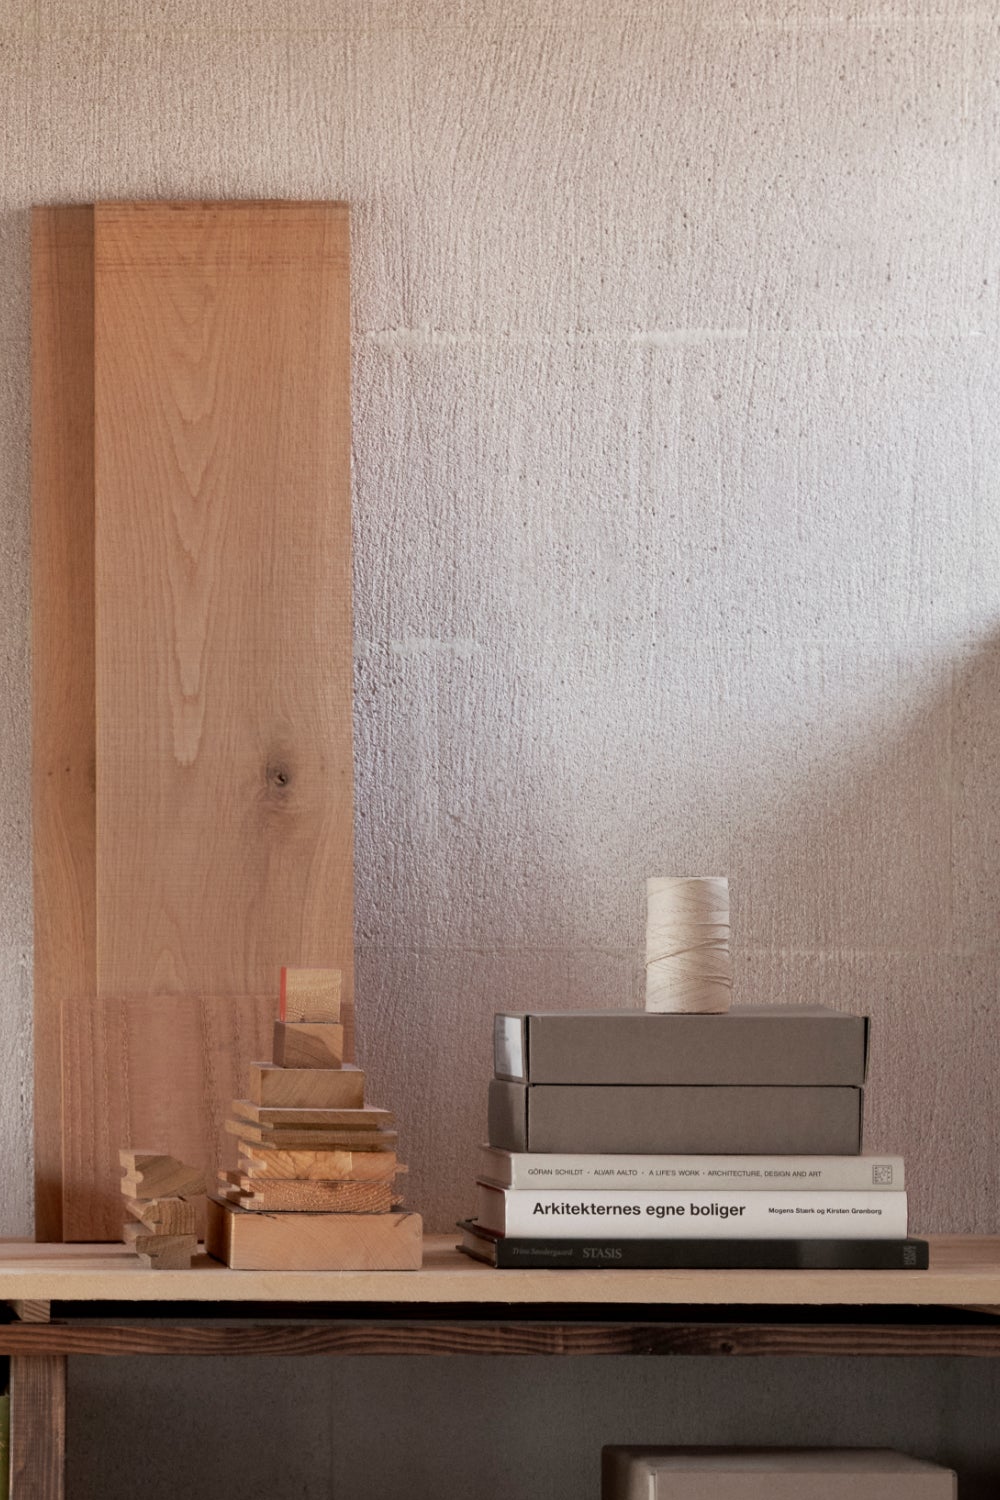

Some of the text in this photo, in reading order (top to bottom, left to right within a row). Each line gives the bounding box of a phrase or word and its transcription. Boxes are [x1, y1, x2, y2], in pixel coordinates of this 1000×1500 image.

[528, 1168, 552, 1176] GÖRAN
[617, 1169, 637, 1177] AALTO
[708, 1170, 762, 1178] ARCHITECTURE,
[533, 1202, 746, 1219] Arkitekternes egne boliger
[768, 1207, 794, 1215] Mogens
[816, 1208, 825, 1216] og
[851, 1207, 882, 1216] Grønborg
[583, 1248, 622, 1259] STASIS
